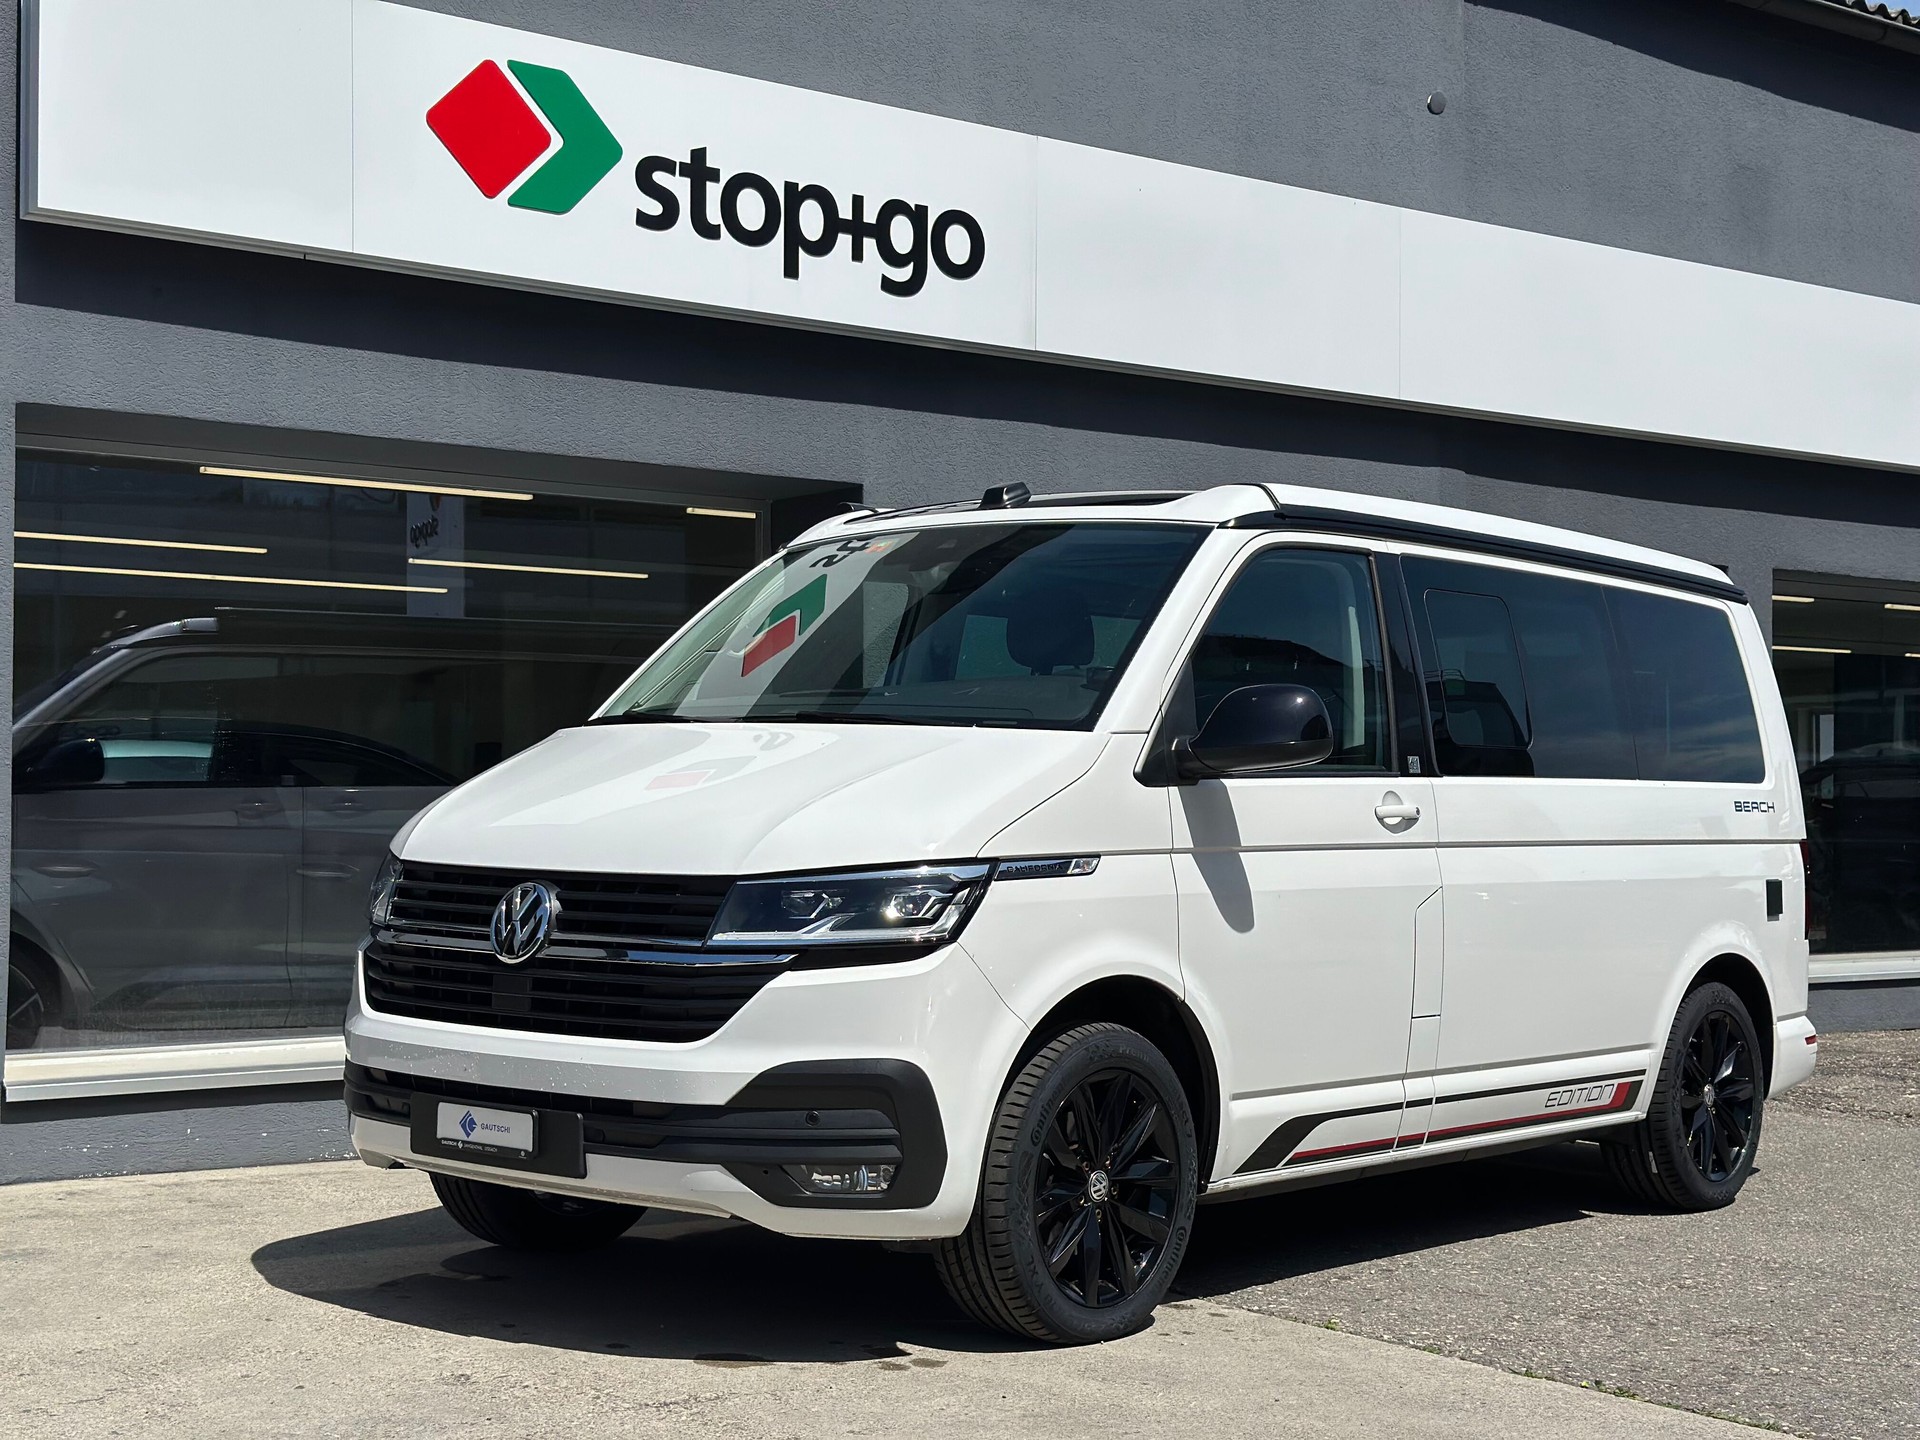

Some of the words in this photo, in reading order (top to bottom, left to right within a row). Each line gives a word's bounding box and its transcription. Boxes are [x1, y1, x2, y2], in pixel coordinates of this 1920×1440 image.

[635, 147, 985, 298] stop+go
[1734, 800, 1776, 813] BEACH
[1544, 1083, 1615, 1108] EDITION
[480, 1122, 511, 1134] GAUTSCHI
